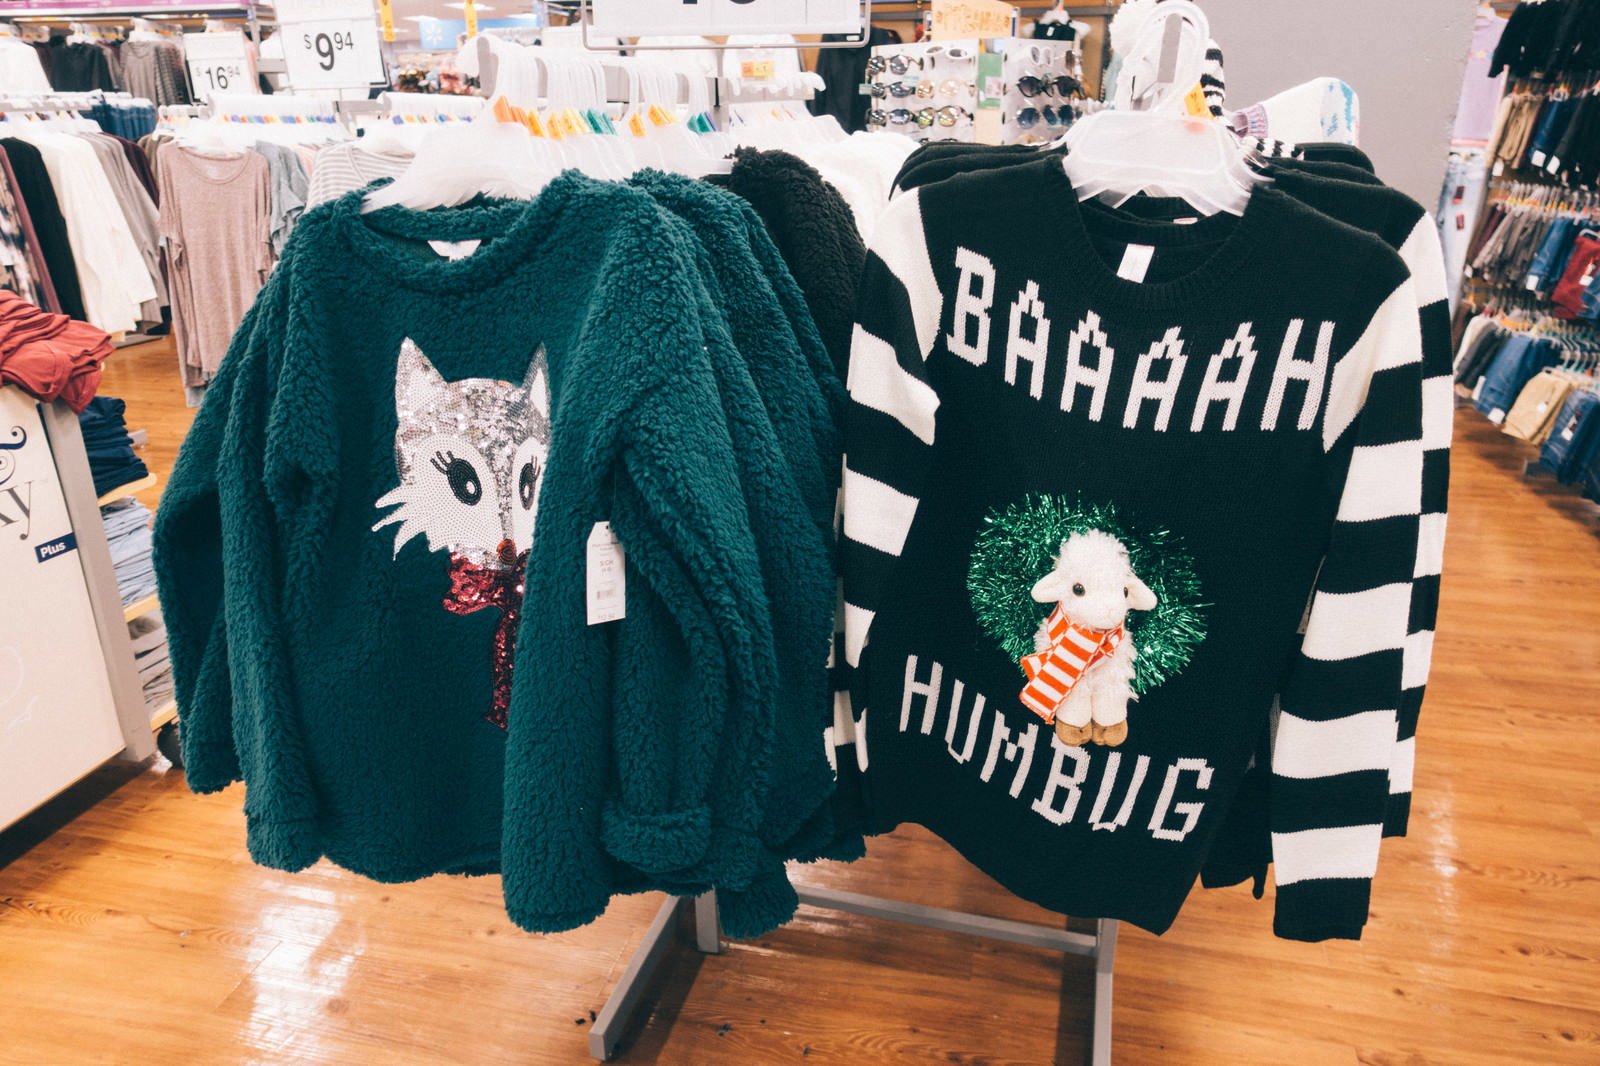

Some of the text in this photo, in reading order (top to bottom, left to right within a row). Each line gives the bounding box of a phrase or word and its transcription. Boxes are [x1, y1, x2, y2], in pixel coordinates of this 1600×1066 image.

[946, 245, 1337, 433] BAAAAH
[39, 541, 67, 559] Plus
[899, 654, 1215, 842] HUMBUG
